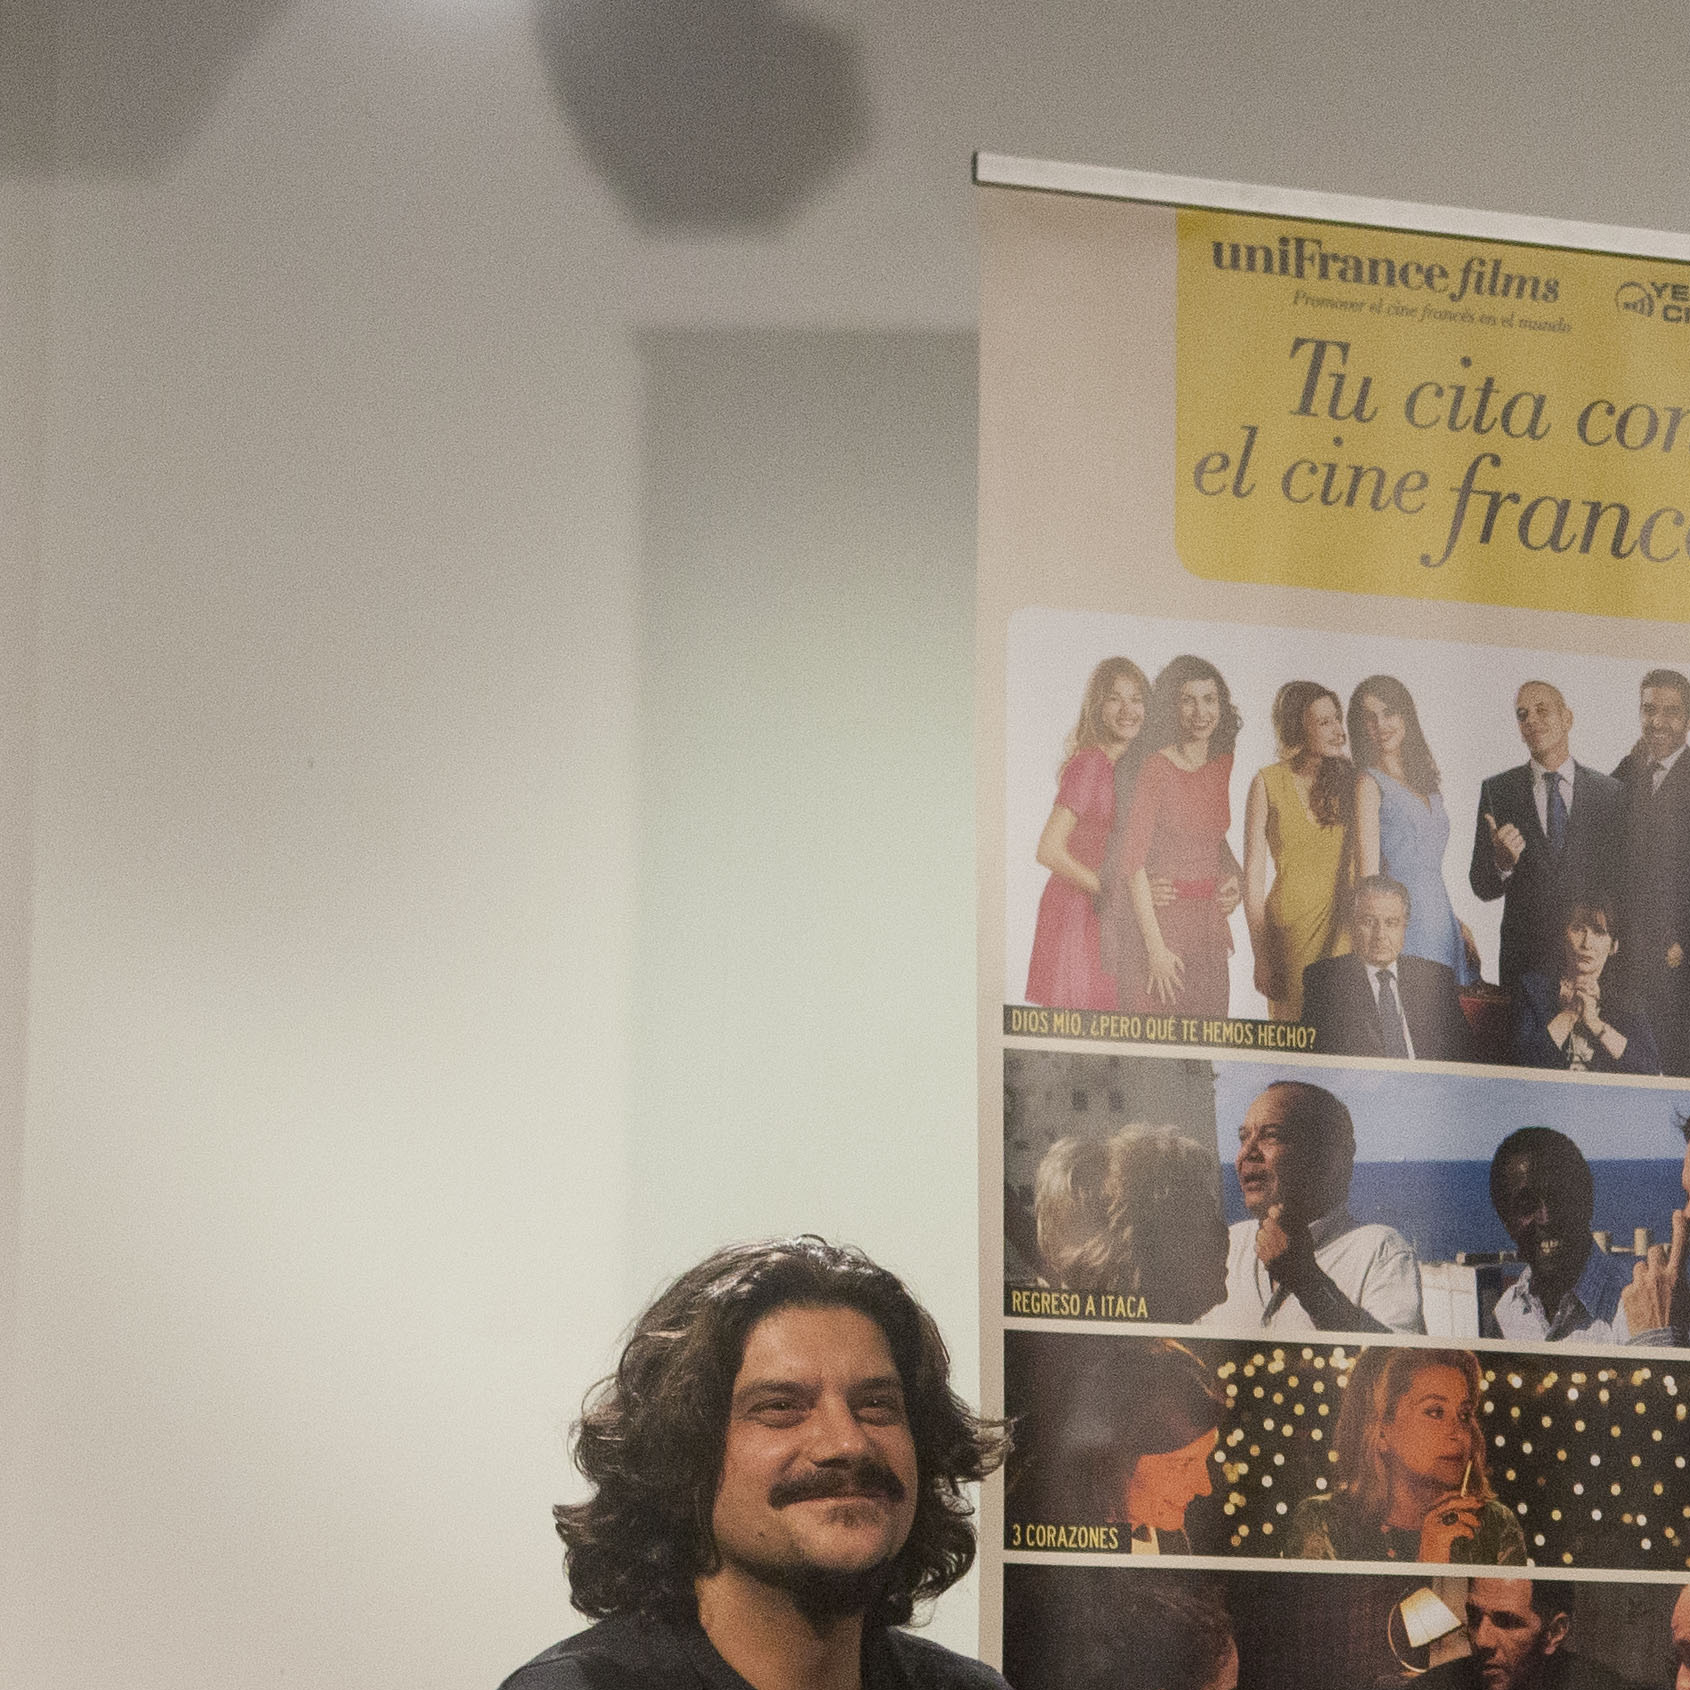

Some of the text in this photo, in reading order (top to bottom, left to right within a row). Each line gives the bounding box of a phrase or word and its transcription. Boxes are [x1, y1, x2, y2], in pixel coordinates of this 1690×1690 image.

[1211, 237, 1560, 303] uniFrance films
[1289, 336, 1380, 424] Tu
[1403, 355, 1551, 442] cita
[1192, 424, 1259, 499] el
[1280, 436, 1430, 515] cine
[1011, 1008, 1048, 1033] DIOS
[1091, 1014, 1141, 1039] ¿PERO
[1182, 1019, 1198, 1042] TE
[1203, 1021, 1254, 1046] HEMOS
[1258, 1024, 1317, 1050] HECHO?
[1012, 1290, 1149, 1318] REGRESO A ITACA
[1012, 1524, 1119, 1549] 3 CORAZONES
